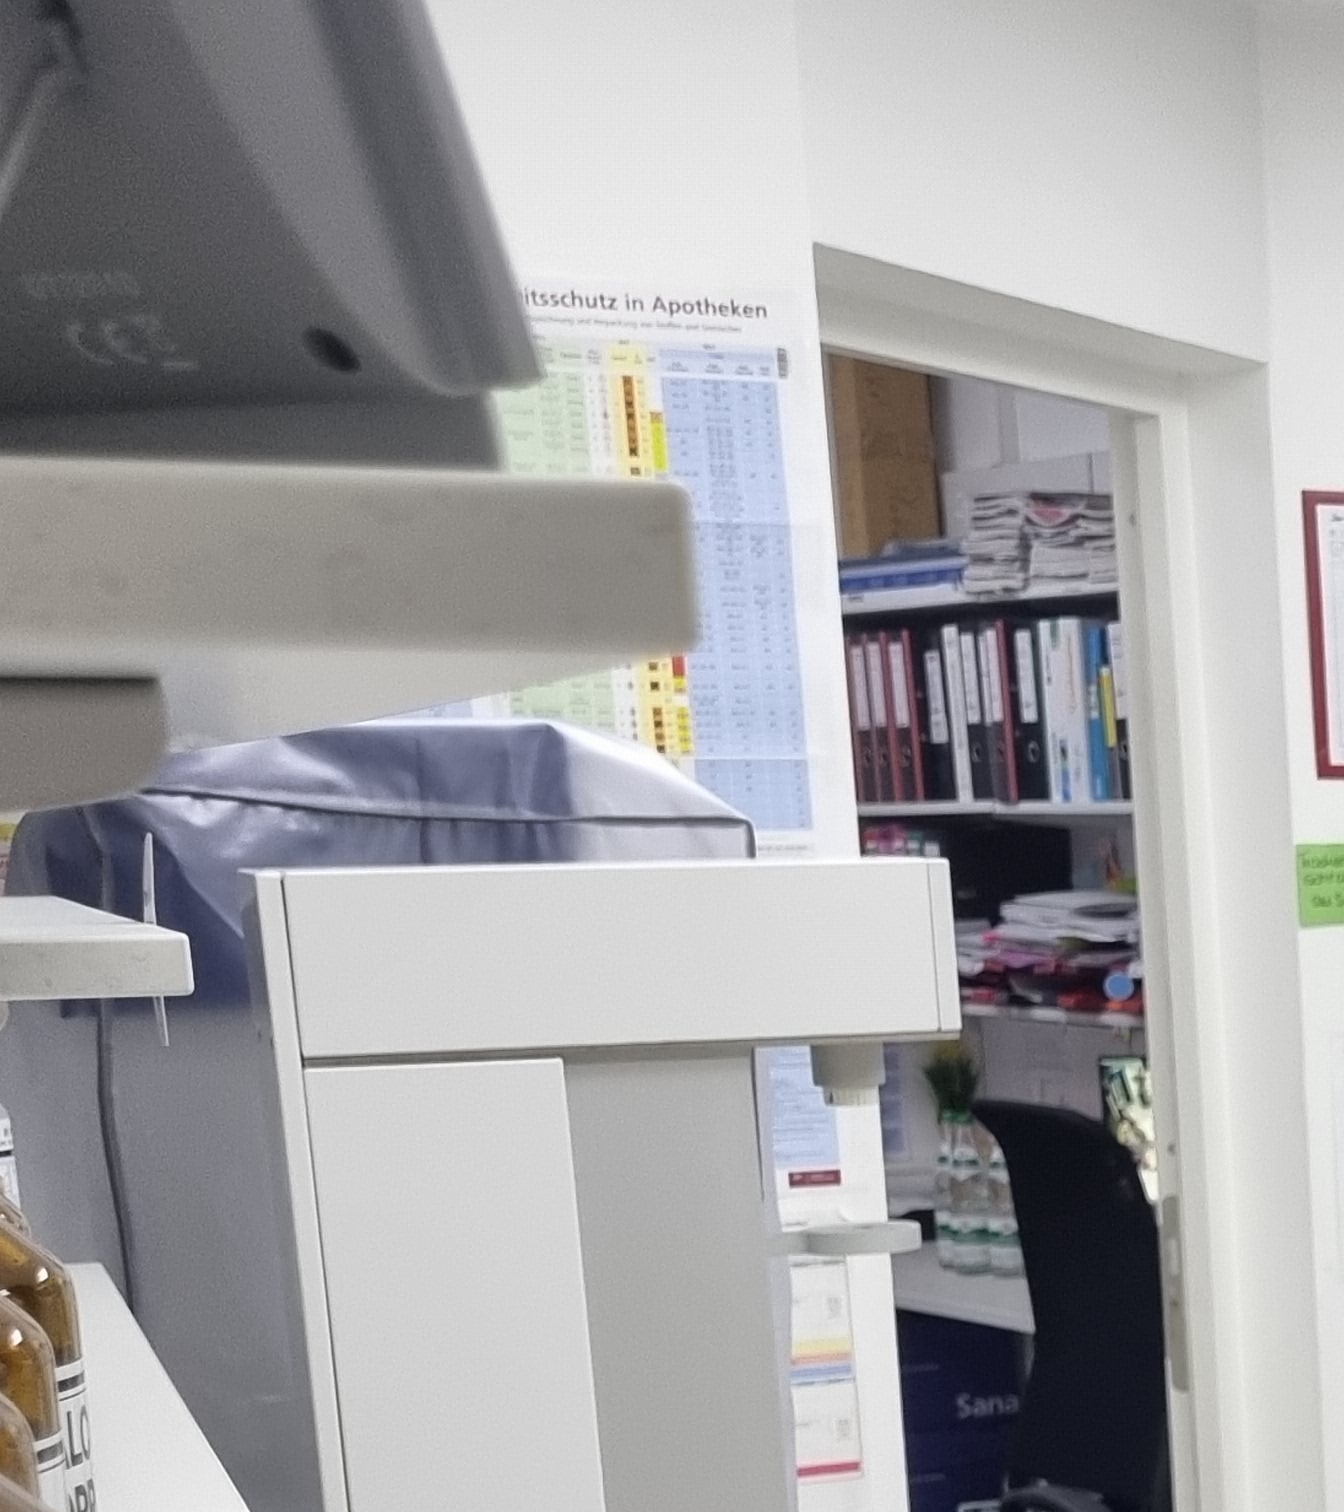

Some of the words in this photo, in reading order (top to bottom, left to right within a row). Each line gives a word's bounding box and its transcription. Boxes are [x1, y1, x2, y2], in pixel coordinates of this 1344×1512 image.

[523, 287, 618, 311] itsschutz
[625, 293, 644, 311] in
[652, 295, 768, 319] Apotheken
[956, 1391, 1020, 1420] Sana
